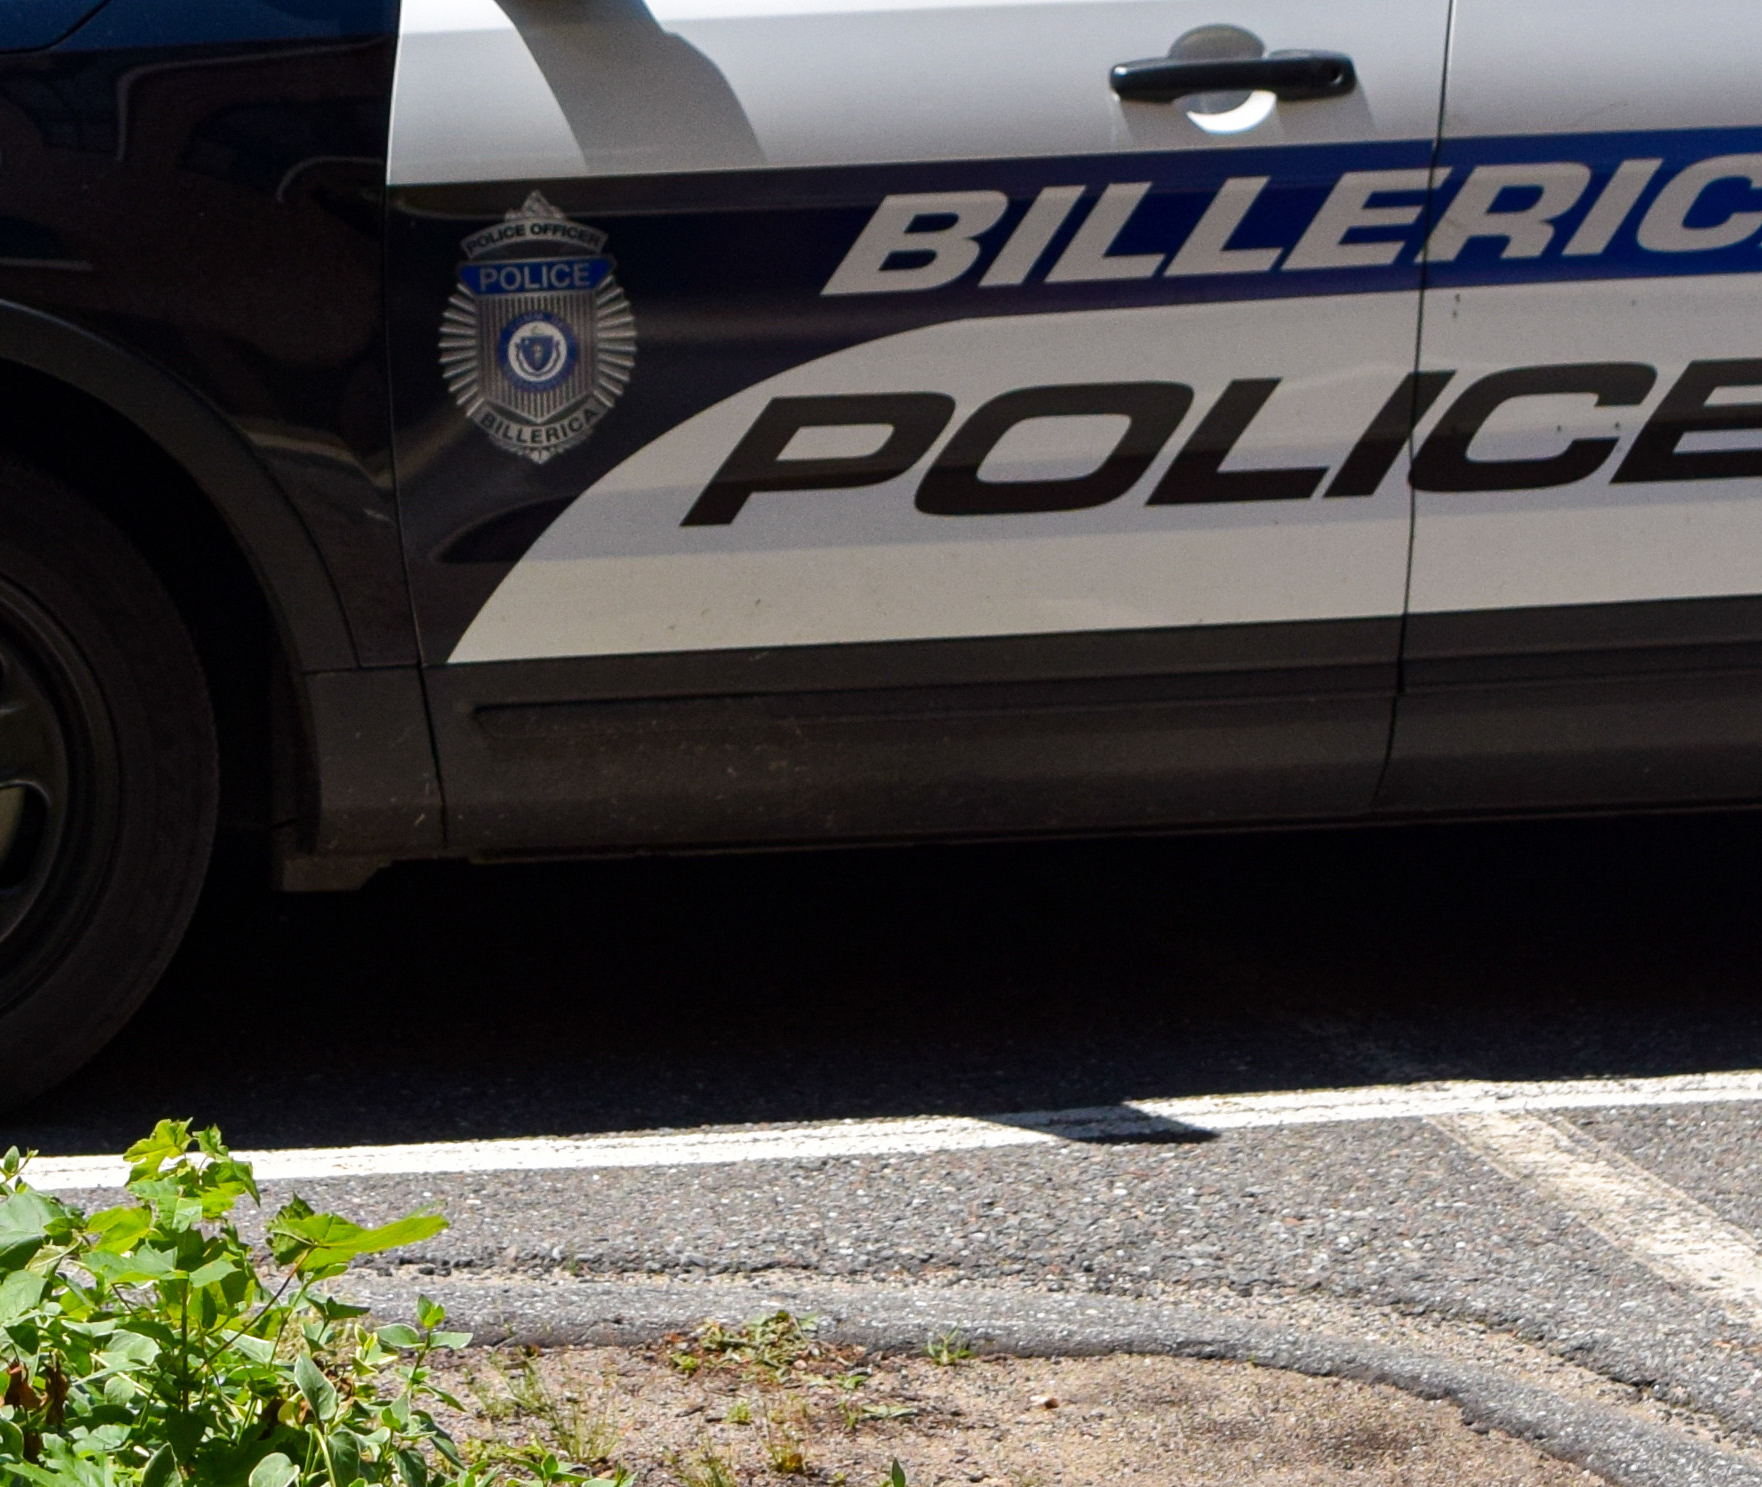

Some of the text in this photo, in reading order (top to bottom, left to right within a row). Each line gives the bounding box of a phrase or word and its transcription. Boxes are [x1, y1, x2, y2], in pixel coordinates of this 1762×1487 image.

[466, 222, 600, 251] POLICE OFFICER
[479, 263, 590, 292] POLICE
[480, 408, 597, 443] BILLERICA
